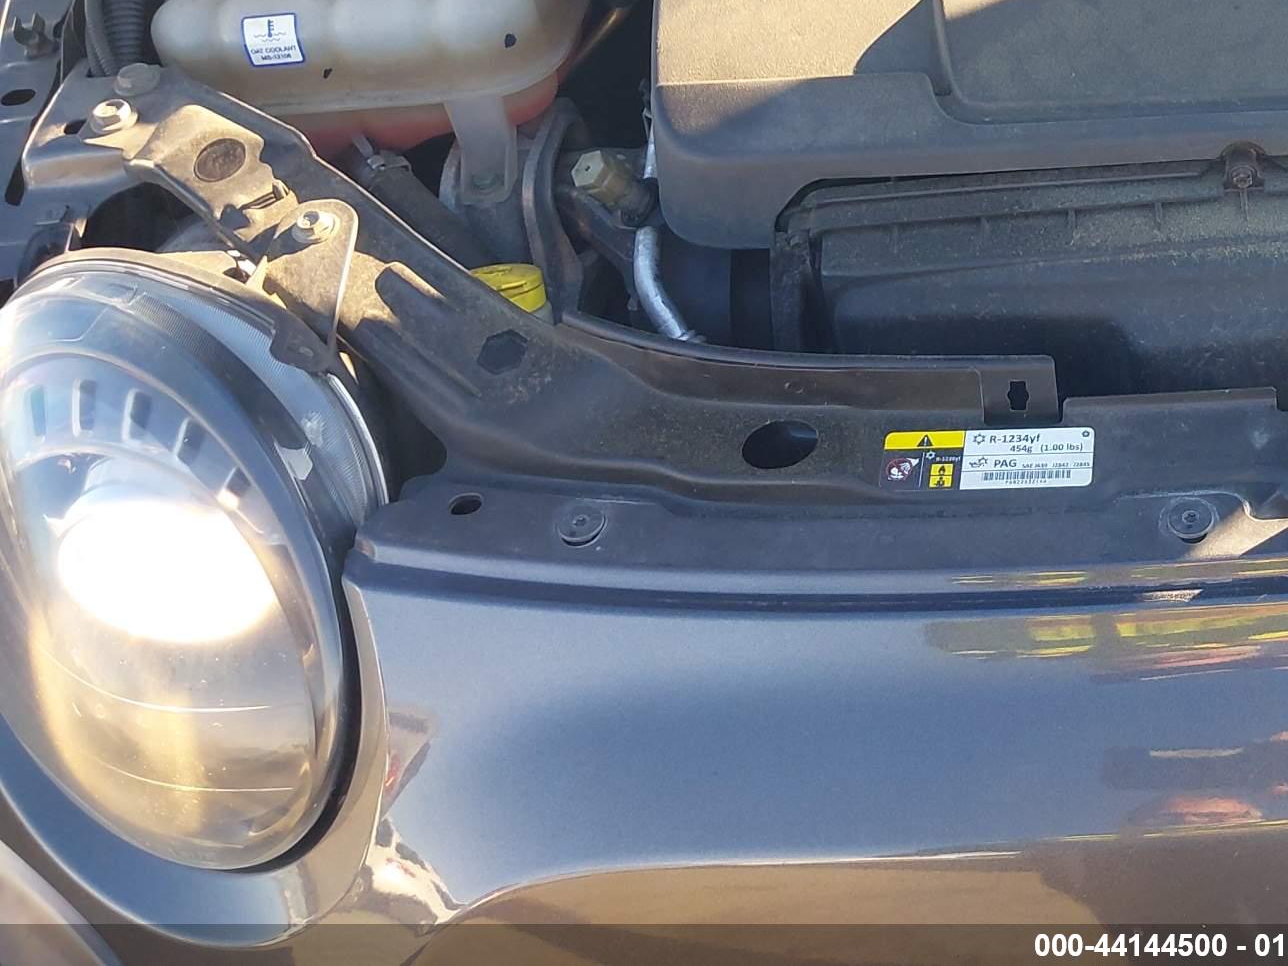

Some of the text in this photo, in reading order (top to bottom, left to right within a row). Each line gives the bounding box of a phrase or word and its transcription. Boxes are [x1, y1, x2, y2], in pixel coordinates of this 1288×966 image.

[989, 433, 1041, 444] R-1234yf
[1010, 442, 1083, 454] 454g (1.00 lbs)
[994, 459, 1017, 468] PAG
